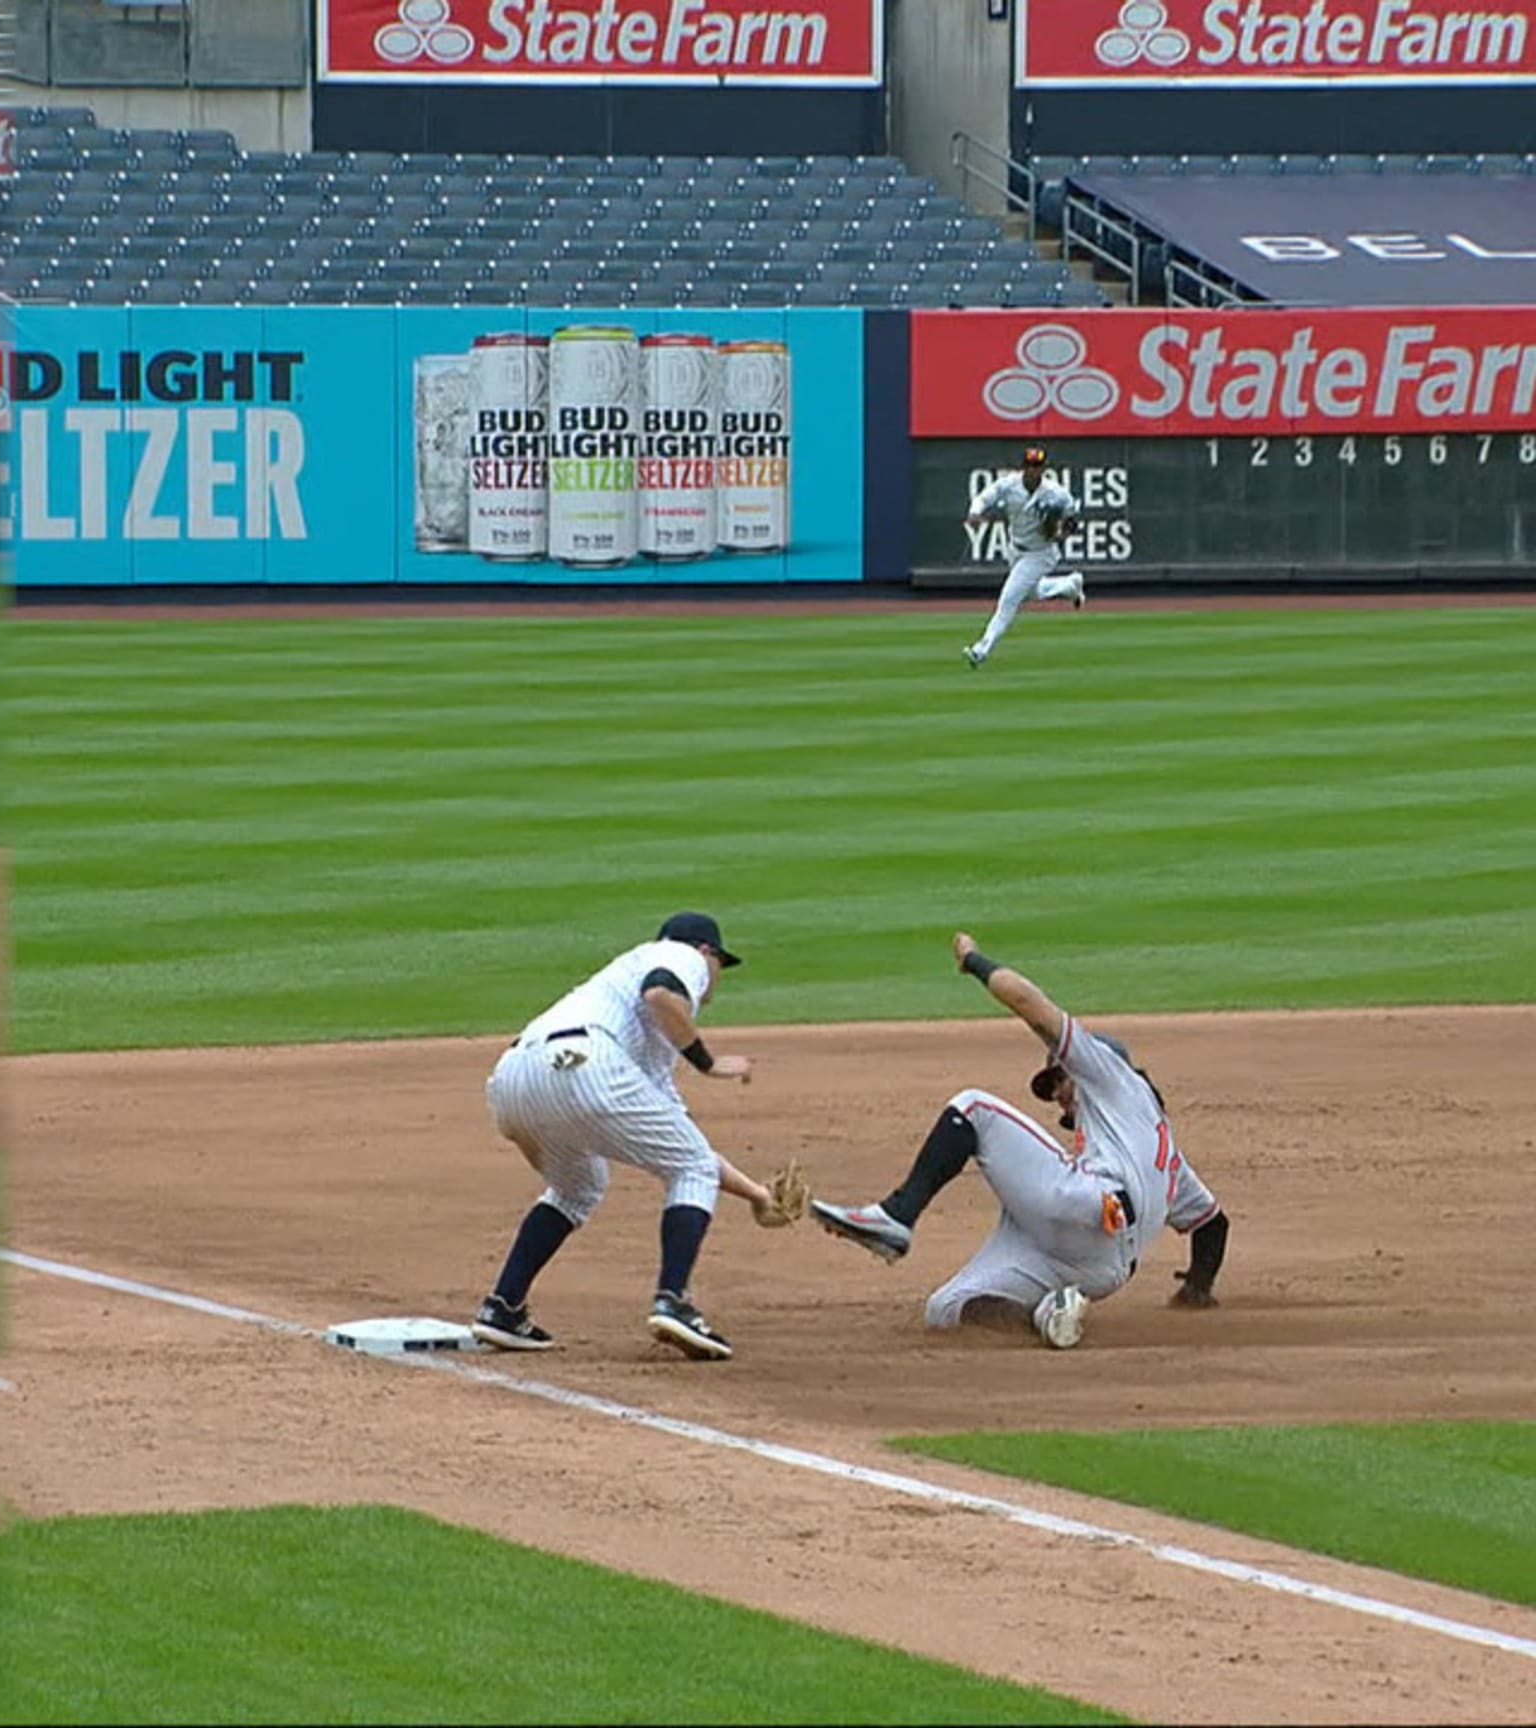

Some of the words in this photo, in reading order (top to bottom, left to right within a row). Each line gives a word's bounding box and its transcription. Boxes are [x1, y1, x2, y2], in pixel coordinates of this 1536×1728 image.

[77, 351, 304, 402] LIGHT
[478, 410, 545, 433] BUD
[559, 407, 628, 431] BUD
[643, 410, 708, 433] BUD
[722, 412, 782, 433] BUD
[1206, 437, 1219, 466] 1
[1250, 437, 1269, 466] 2
[1294, 437, 1314, 466] 3
[1338, 437, 1357, 466] 4
[1383, 437, 1403, 466] 5
[1429, 437, 1448, 466] 6
[1477, 437, 1494, 466] 7
